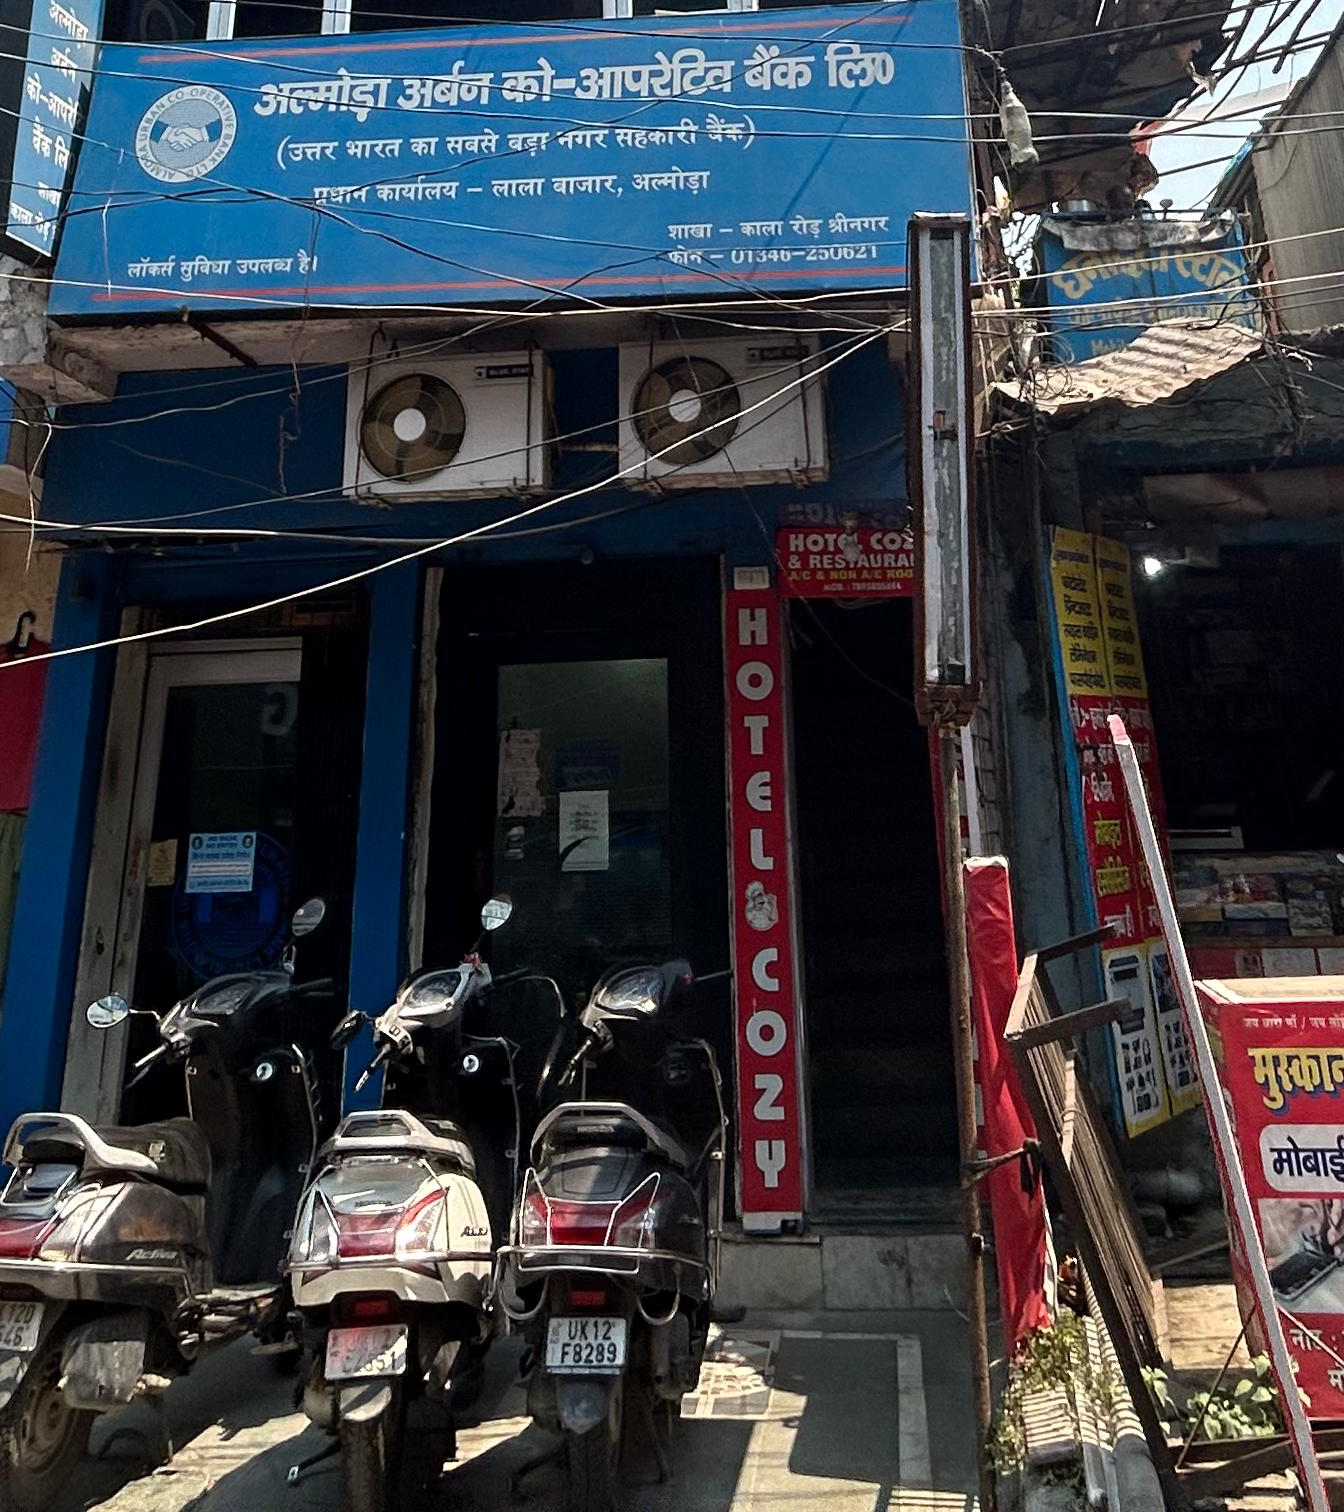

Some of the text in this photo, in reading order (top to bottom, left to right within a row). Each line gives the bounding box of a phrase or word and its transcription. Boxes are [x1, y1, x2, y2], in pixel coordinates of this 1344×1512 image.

[253, 68, 391, 122] अल्मोड़ा
[397, 61, 494, 109] अर्बन
[502, 48, 735, 104] को-आपरेटिव
[744, 44, 815, 90] बैंक
[347, 136, 402, 159] भारत
[410, 136, 438, 157] का
[446, 128, 499, 155] सबसे
[507, 131, 549, 157] बड़ा
[558, 129, 608, 150] नगर
[616, 118, 698, 149] सहकारी
[376, 174, 459, 202] कार्यालय
[492, 176, 544, 198] लाला
[632, 166, 710, 195] अल्मोड़ा
[667, 223, 713, 240] शाखा
[739, 220, 784, 237] काला
[790, 215, 822, 239] रोड़
[828, 212, 889, 233] श्रीनगर
[127, 255, 176, 278] लॉकर्स
[180, 254, 232, 282] सुविधा
[236, 257, 294, 275] उपलब्ध
[870, 531, 914, 553] COZ
[788, 553, 914, 569] & RESAURA
[886, 568, 913, 579] ROO
[736, 607, 775, 872] HOTEL
[745, 946, 788, 1189] COZY
[560, 1342, 618, 1364] F8289
